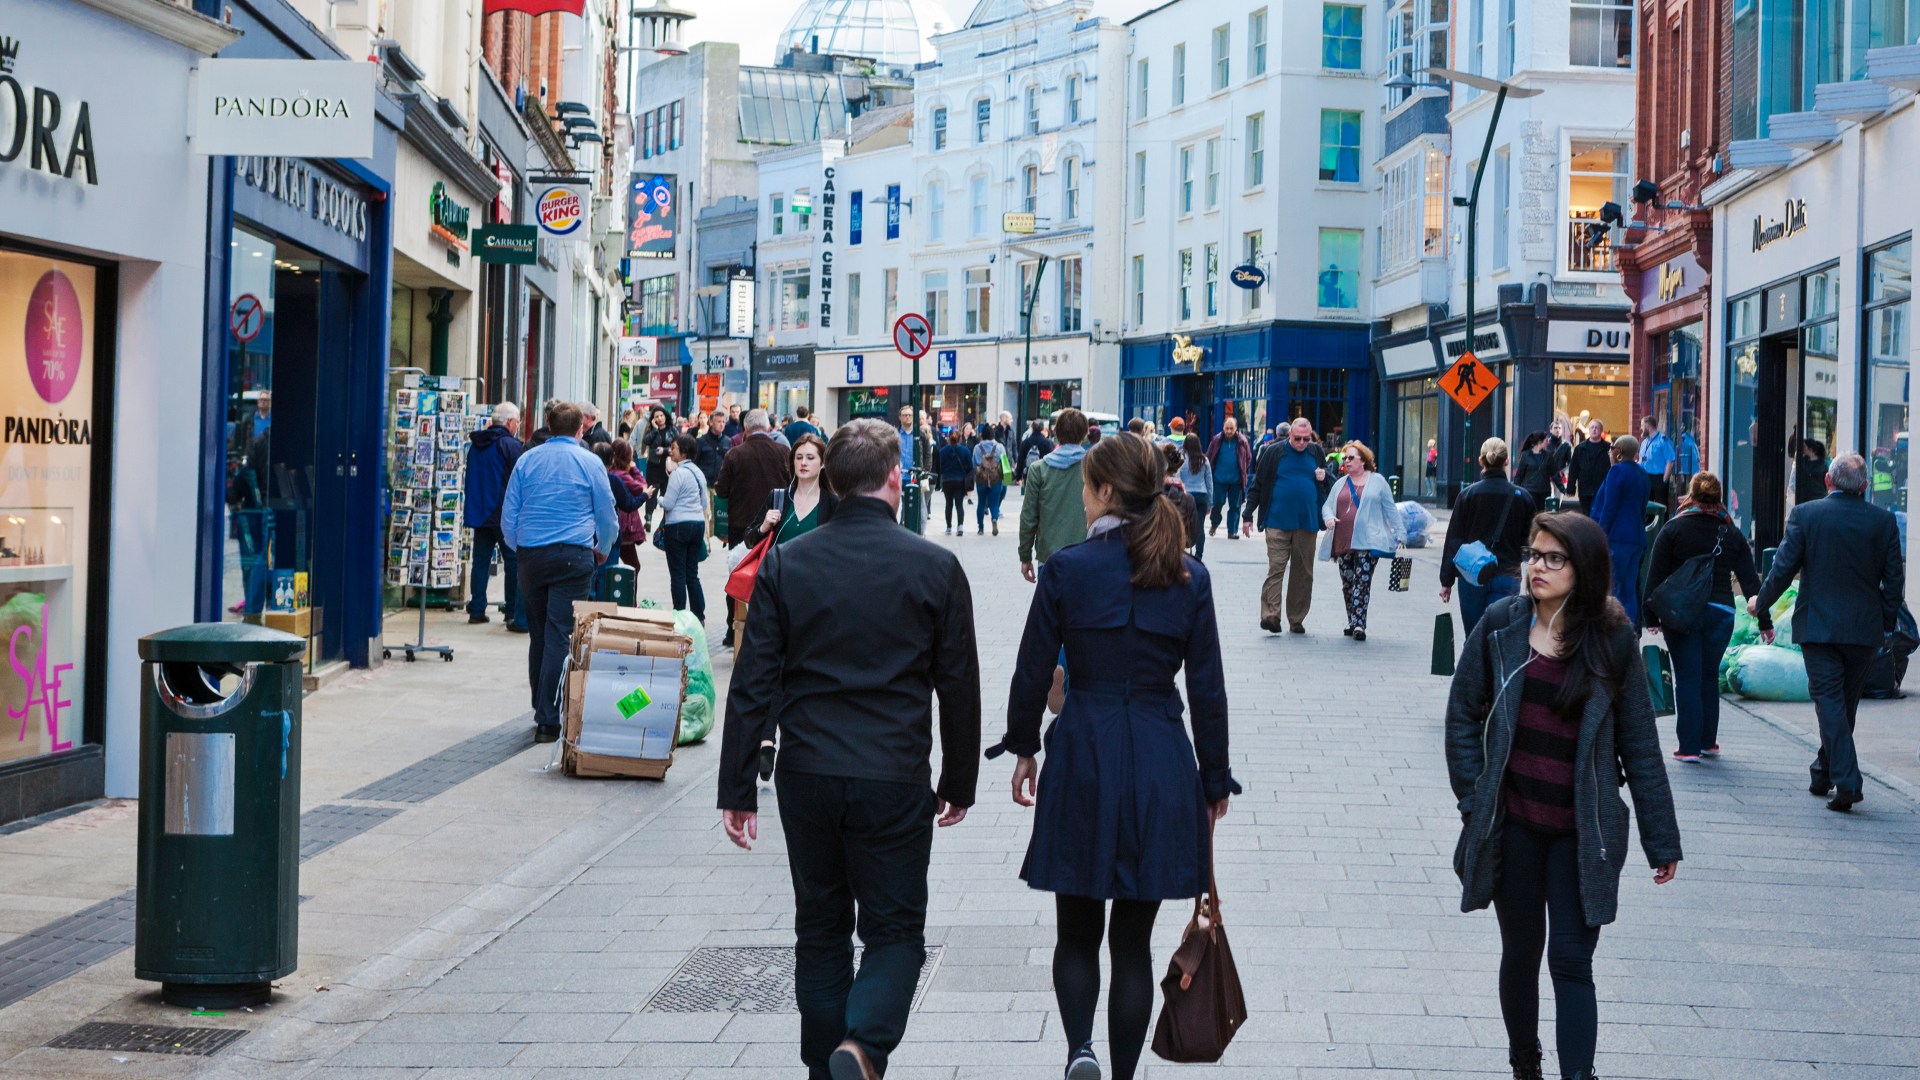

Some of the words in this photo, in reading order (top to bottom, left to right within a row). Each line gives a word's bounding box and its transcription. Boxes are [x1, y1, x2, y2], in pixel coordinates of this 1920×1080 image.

[214, 96, 350, 119] PANDORA
[318, 176, 367, 243] BOOKS
[541, 196, 579, 212] BURGER
[542, 205, 580, 224] KING
[822, 167, 836, 244] CAMERA
[1784, 198, 1806, 238] Dutti
[820, 251, 833, 328] CENTRE
[1234, 269, 1262, 285] Disney
[43, 295, 67, 348] SALE
[737, 284, 747, 334] FUJIFILM
[42, 359, 66, 381] 70%
[1171, 333, 1204, 373] Disney
[4, 416, 91, 445] PANDORA
[6, 603, 74, 752] SALE
